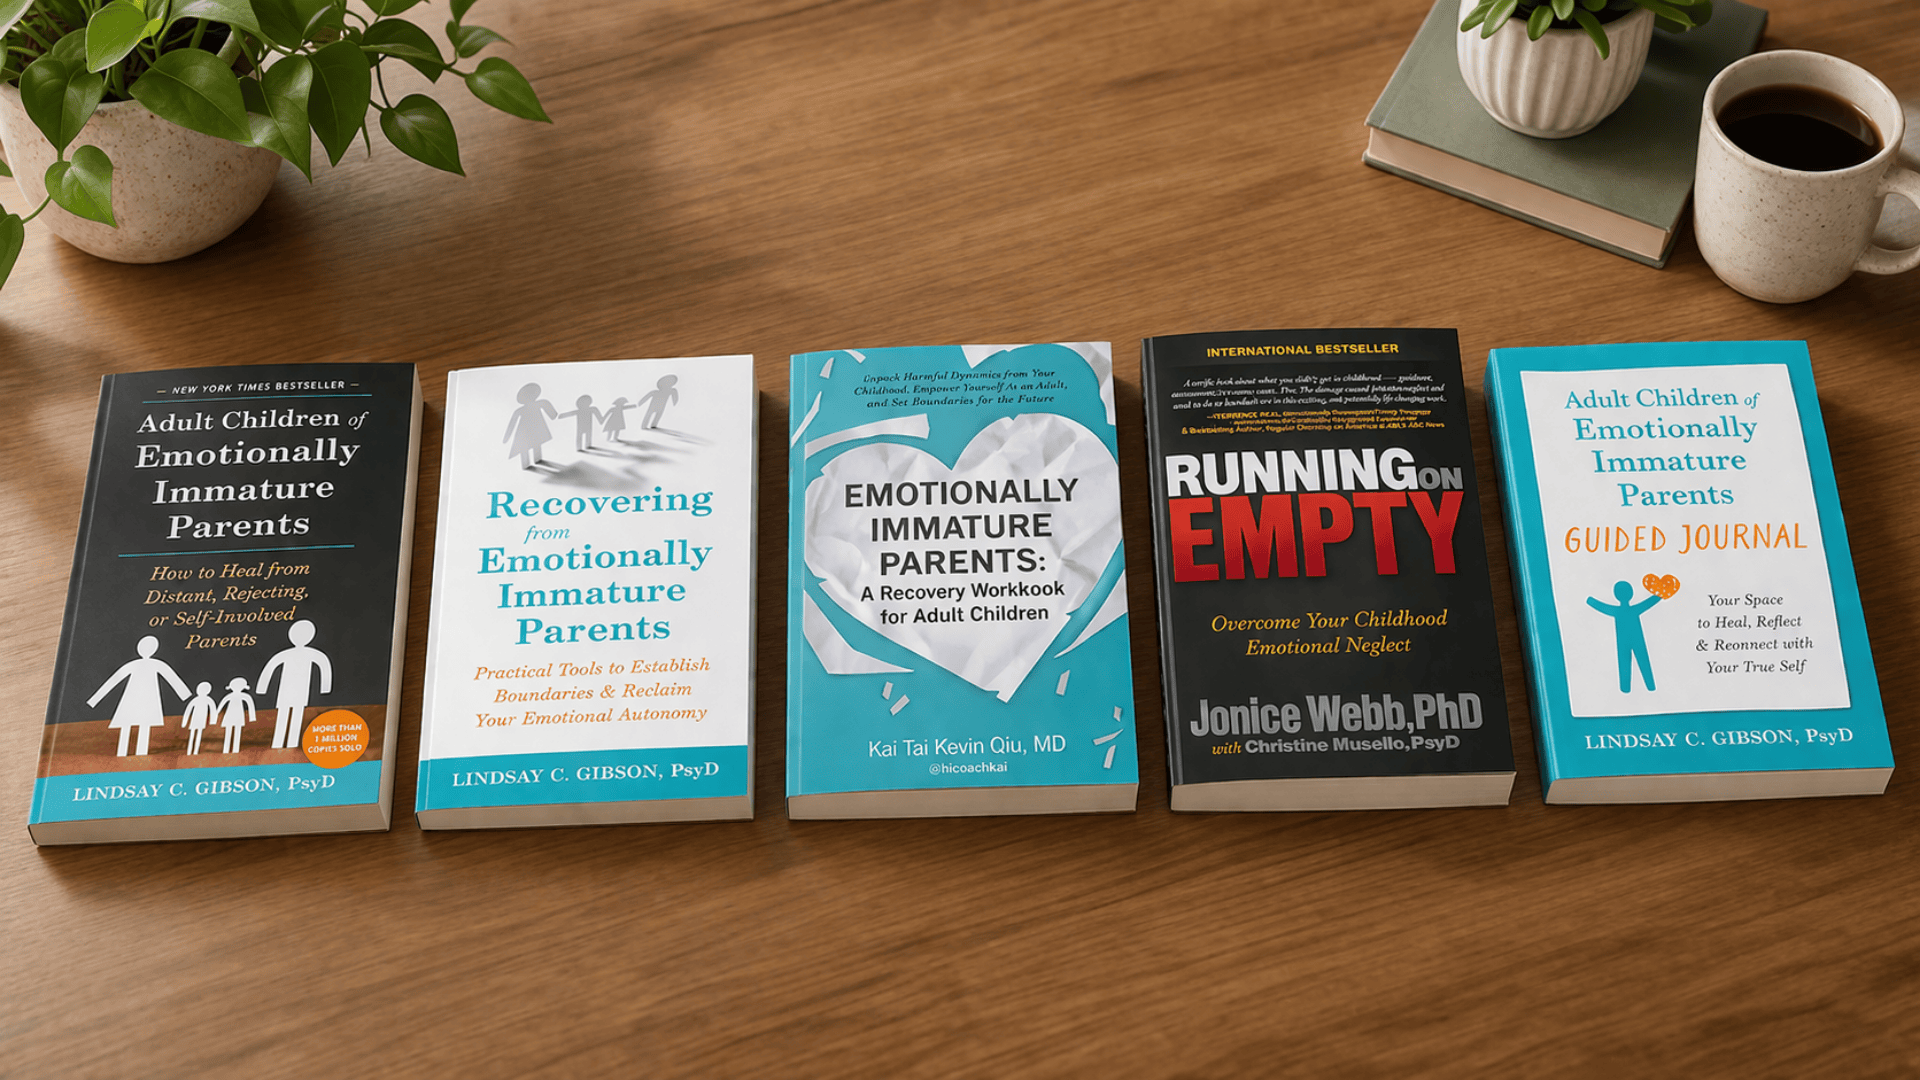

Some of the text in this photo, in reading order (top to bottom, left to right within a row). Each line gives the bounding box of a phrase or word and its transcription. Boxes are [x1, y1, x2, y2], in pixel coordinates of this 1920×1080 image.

[1206, 343, 1400, 357] INTERNATIONAL BESTSELLER
[903, 371, 949, 383] Harmful
[1003, 370, 1029, 381] from
[1032, 369, 1055, 378] Your
[172, 381, 345, 395] NEW YORK TIMES BESTSELLER
[913, 384, 960, 395] Empower
[1020, 383, 1034, 391] an
[1035, 380, 1068, 391] Adult,
[1564, 387, 1760, 409] Adult Children of
[867, 394, 1055, 408] and Set Boundaries for the Future
[137, 409, 370, 433] Adult Children of
[1572, 415, 1758, 444] Emotionally
[134, 437, 360, 469] Emotionally
[1591, 450, 1747, 473] Immature
[1165, 447, 1464, 497] RUNNING ON
[152, 478, 335, 505] Immature
[486, 486, 714, 519] Recovering
[845, 478, 1079, 508] EMOTIONALLY
[1617, 483, 1735, 507] Parents
[166, 513, 310, 540] Parents
[523, 525, 571, 544] from
[872, 513, 1052, 542] IMMATURE
[1168, 491, 1465, 583] EMPTY
[1564, 523, 1808, 555] GUIDED JOURNAL
[477, 539, 714, 574] Emotionally
[880, 548, 1046, 575] PARENTS:
[150, 562, 310, 581] How to Heal from
[144, 584, 310, 605] Distant, Rejecting,
[497, 581, 686, 609] Immature
[861, 586, 874, 602] A
[881, 585, 965, 602] Recovery
[1708, 593, 1784, 609] Your Space
[148, 605, 297, 628] or Self-Involved
[880, 605, 1049, 624] for Adult Children
[1211, 608, 1448, 632] Overcome Your Childhood
[1697, 615, 1803, 630] to Heal, Reflect
[185, 633, 257, 650] Parents
[514, 616, 671, 645] Parents
[1246, 635, 1411, 657] Emotional Neglect
[1695, 637, 1815, 651] & Reonnect with
[473, 657, 711, 681] Practical Tools to Establish
[1706, 659, 1808, 675] Your True Self
[493, 682, 693, 704] Boundaries & Reclaim
[339, 723, 363, 732] THAN
[475, 707, 708, 728] Your Emotional Autonomy
[1190, 696, 1302, 737] Jonice
[321, 733, 358, 743] MILLION
[868, 734, 1067, 757] Kai Tai Kevin Qiu, MD
[1212, 741, 1242, 755] with
[1245, 738, 1329, 754] Christine
[1585, 728, 1854, 749] LINDSAY C. GIBSON, PsyD
[452, 761, 720, 787] LINDSAY C. GIBSON, PsyD
[929, 761, 1008, 776] @hicoachkai
[72, 774, 336, 802] LINDSAY C. GIBSON, PsyD
